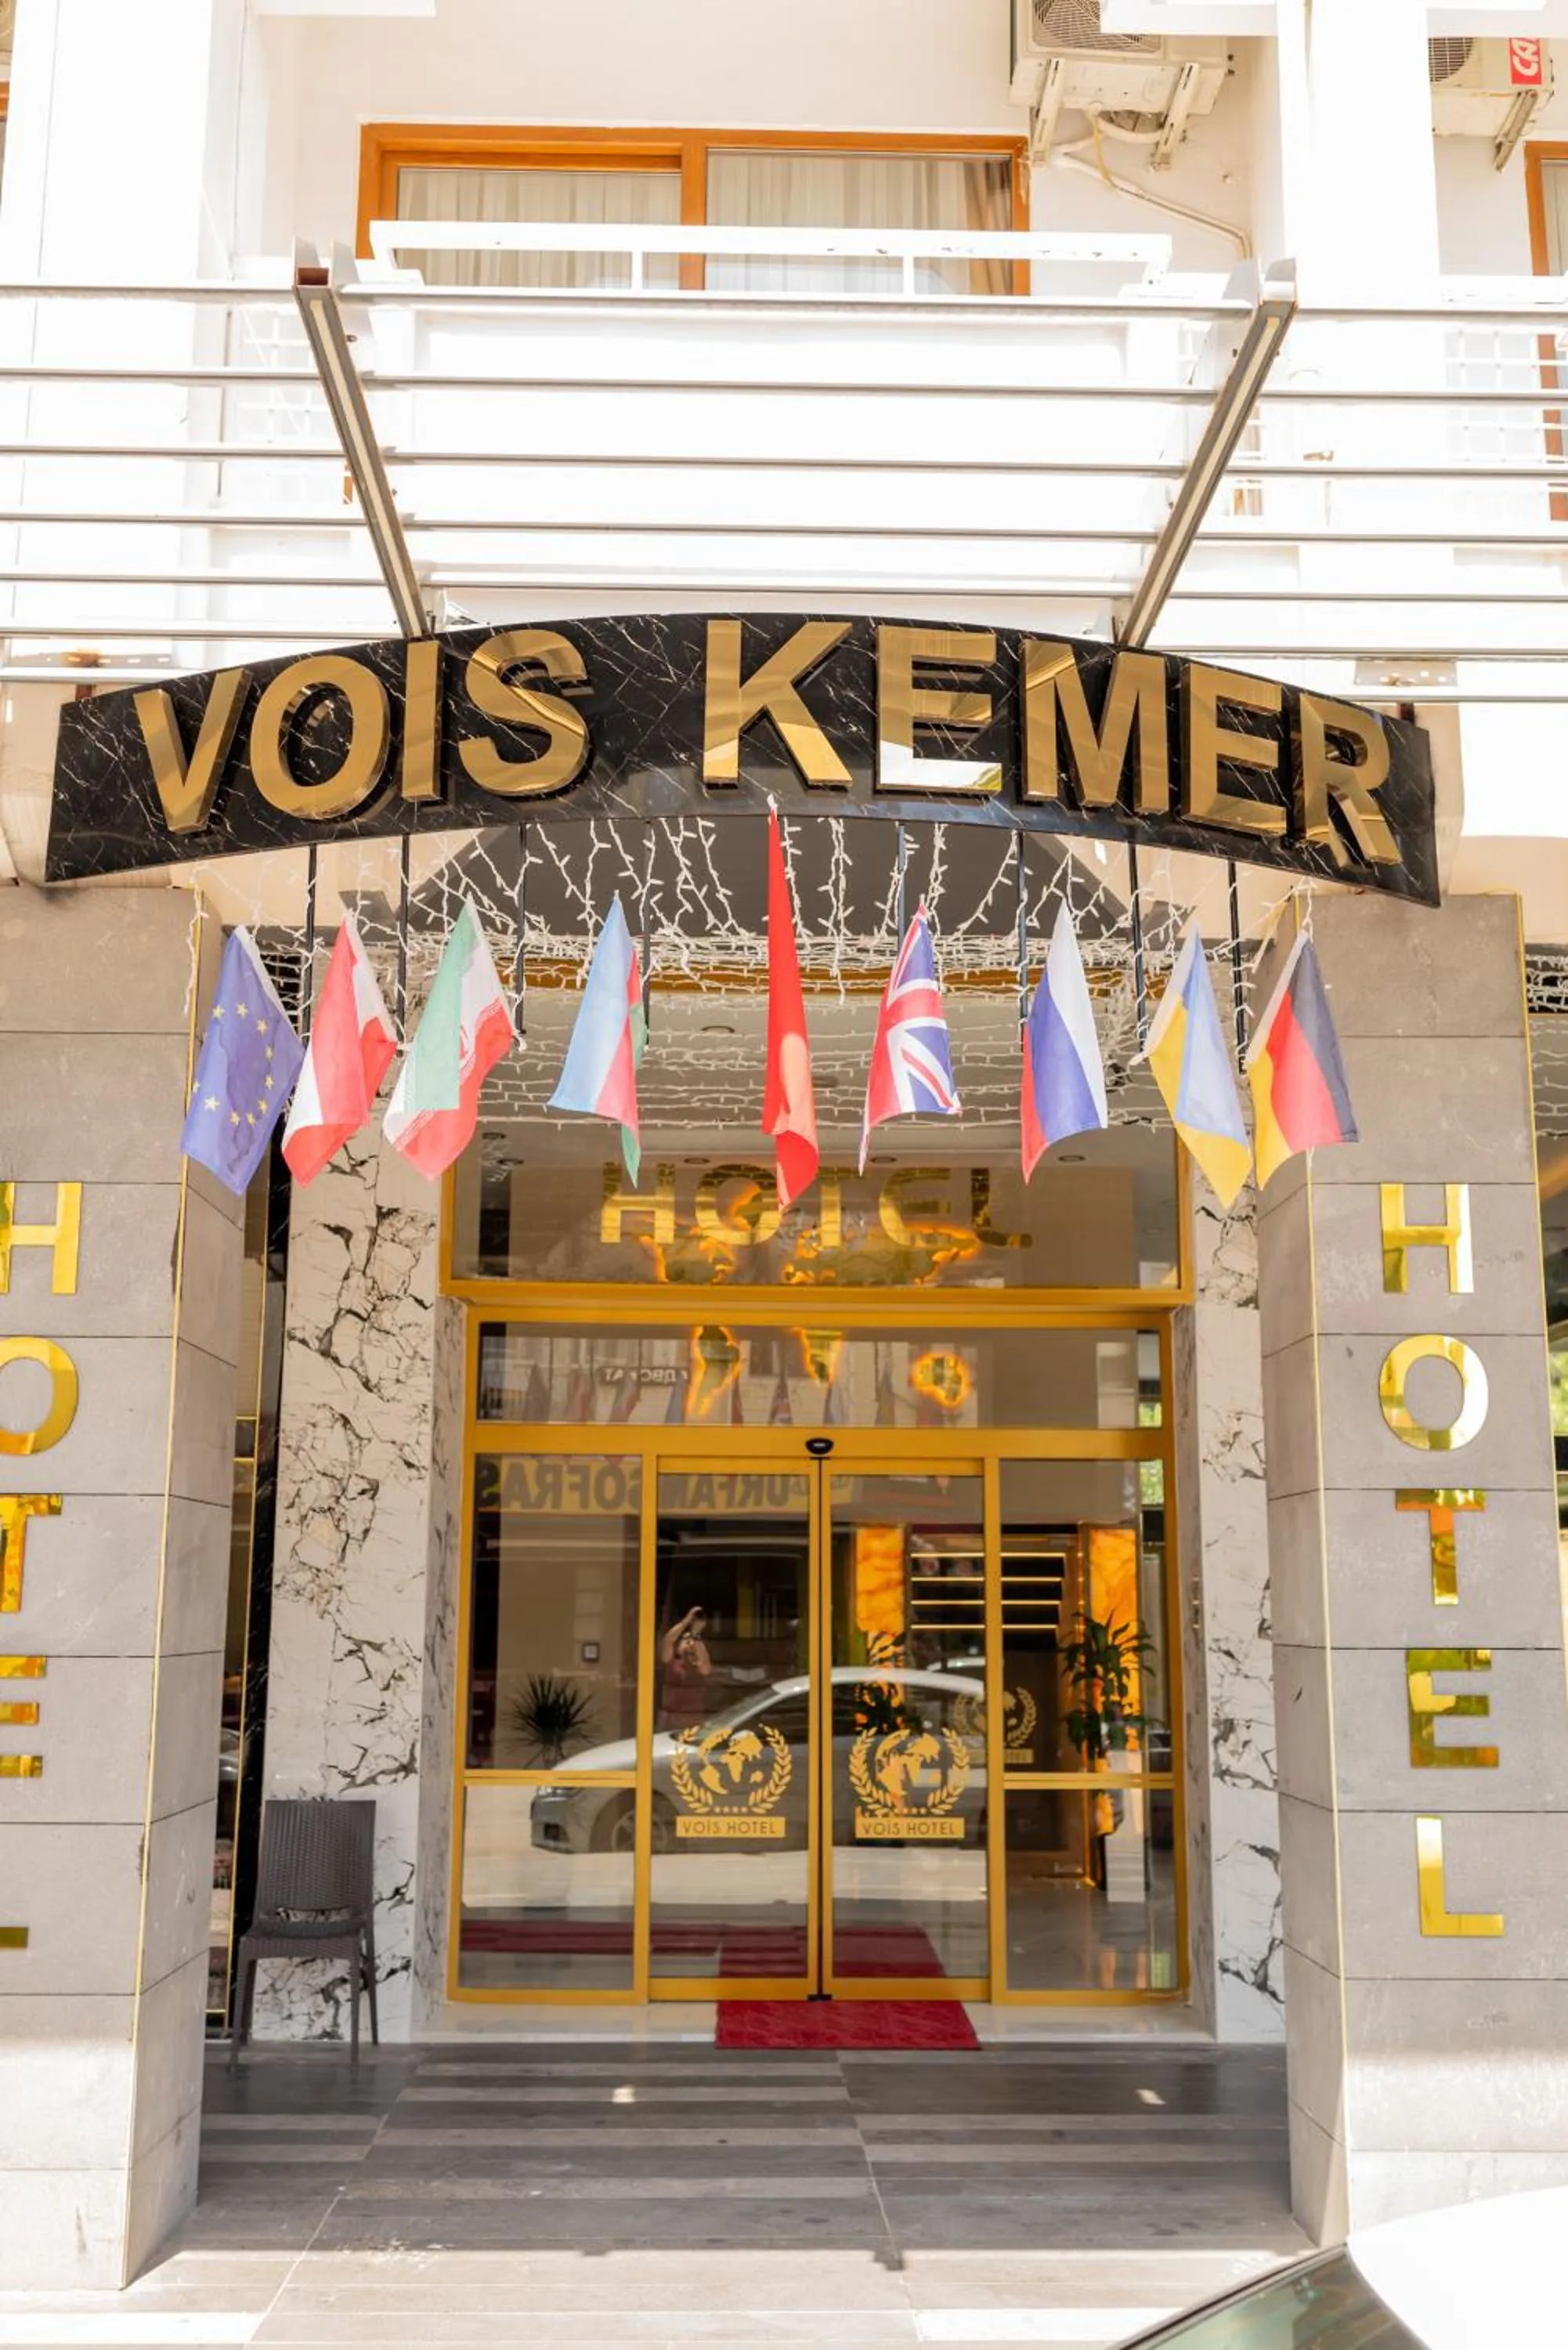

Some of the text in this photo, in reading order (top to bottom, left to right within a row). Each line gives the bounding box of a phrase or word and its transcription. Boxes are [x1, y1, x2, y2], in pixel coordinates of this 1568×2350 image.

[1511, 38, 1539, 77] CA
[133, 620, 1402, 866] VOIS KEMER
[601, 1162, 1033, 1248] HOTEL
[1379, 1182, 1505, 1937] HOTEL
[727, 1820, 776, 1835] HOTEL
[907, 1821, 956, 1835] HOTEL
